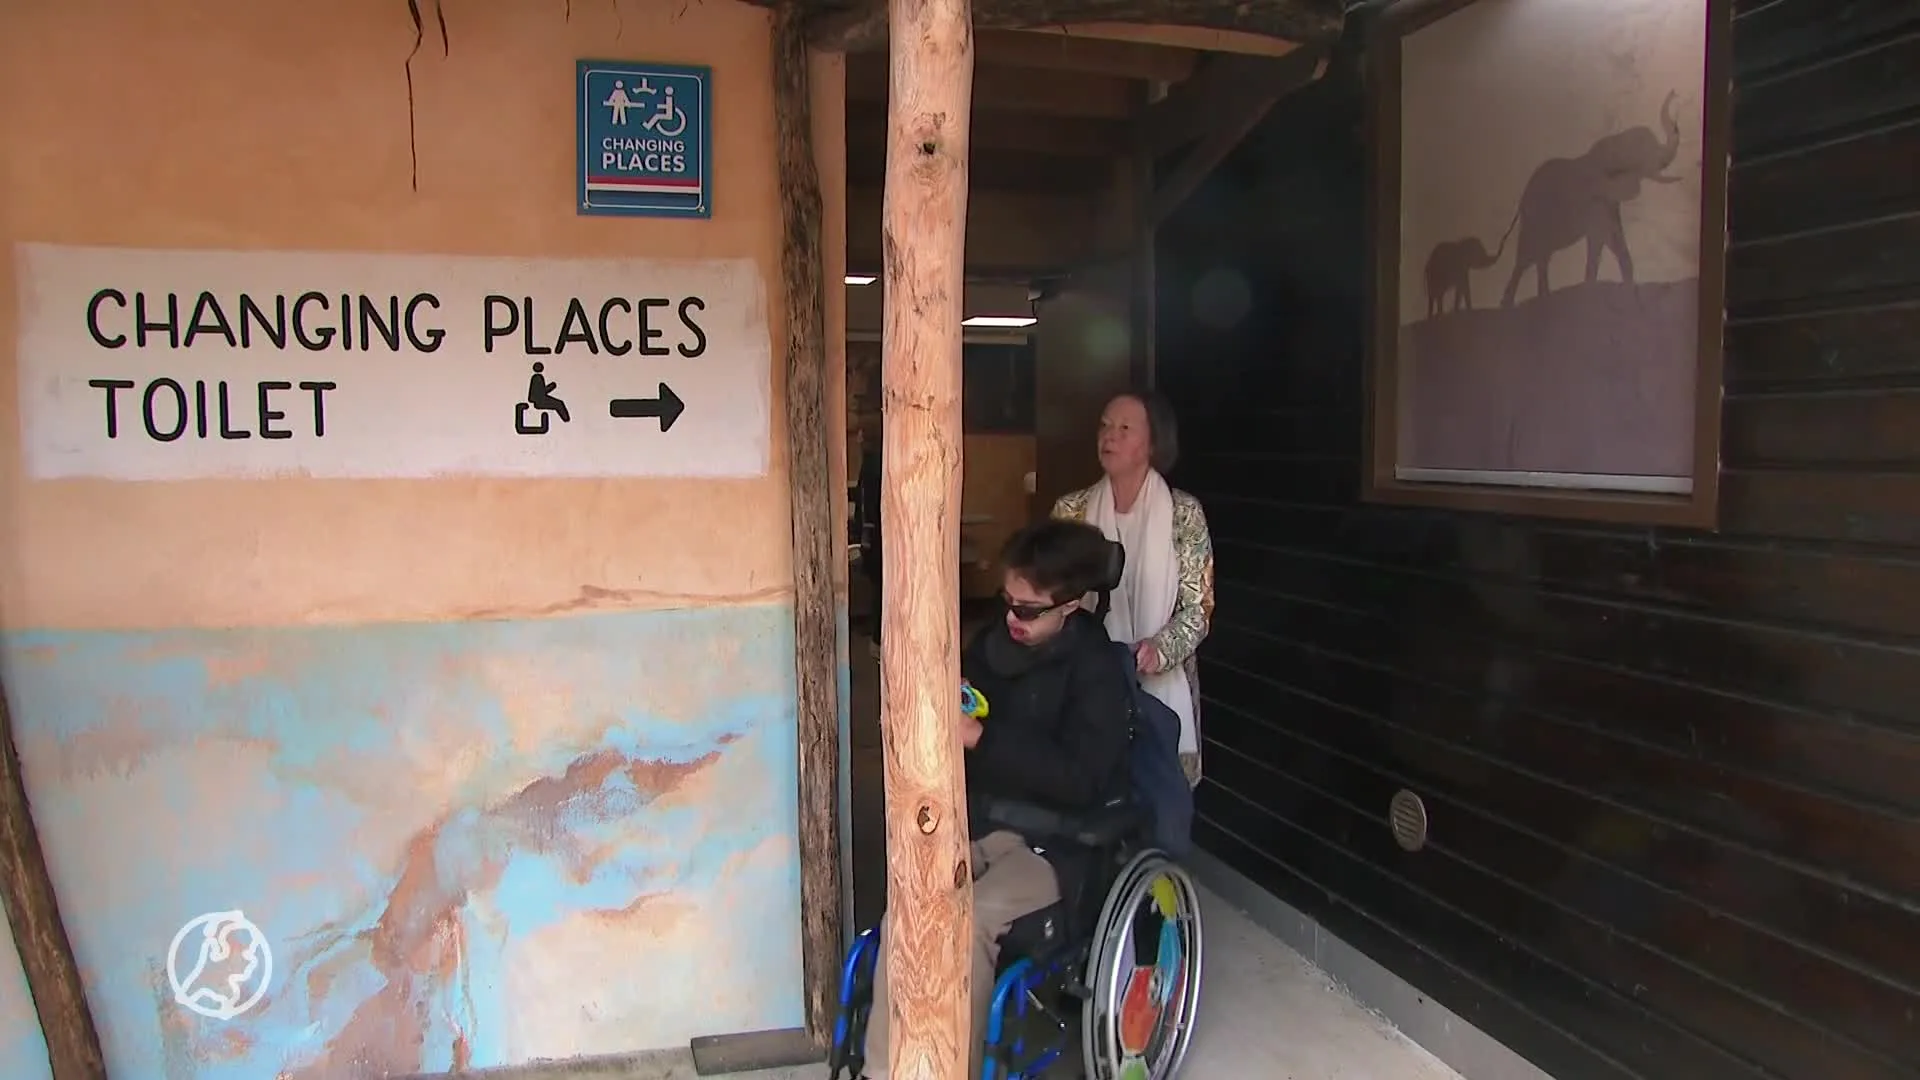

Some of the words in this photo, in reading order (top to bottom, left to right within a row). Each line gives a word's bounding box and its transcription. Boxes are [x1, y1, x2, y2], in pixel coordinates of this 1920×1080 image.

[602, 137, 685, 153] CHANGING
[602, 152, 686, 172] PLACES
[86, 288, 447, 354] CHANGING
[483, 295, 707, 359] PLACES
[88, 377, 337, 442] TOILET
